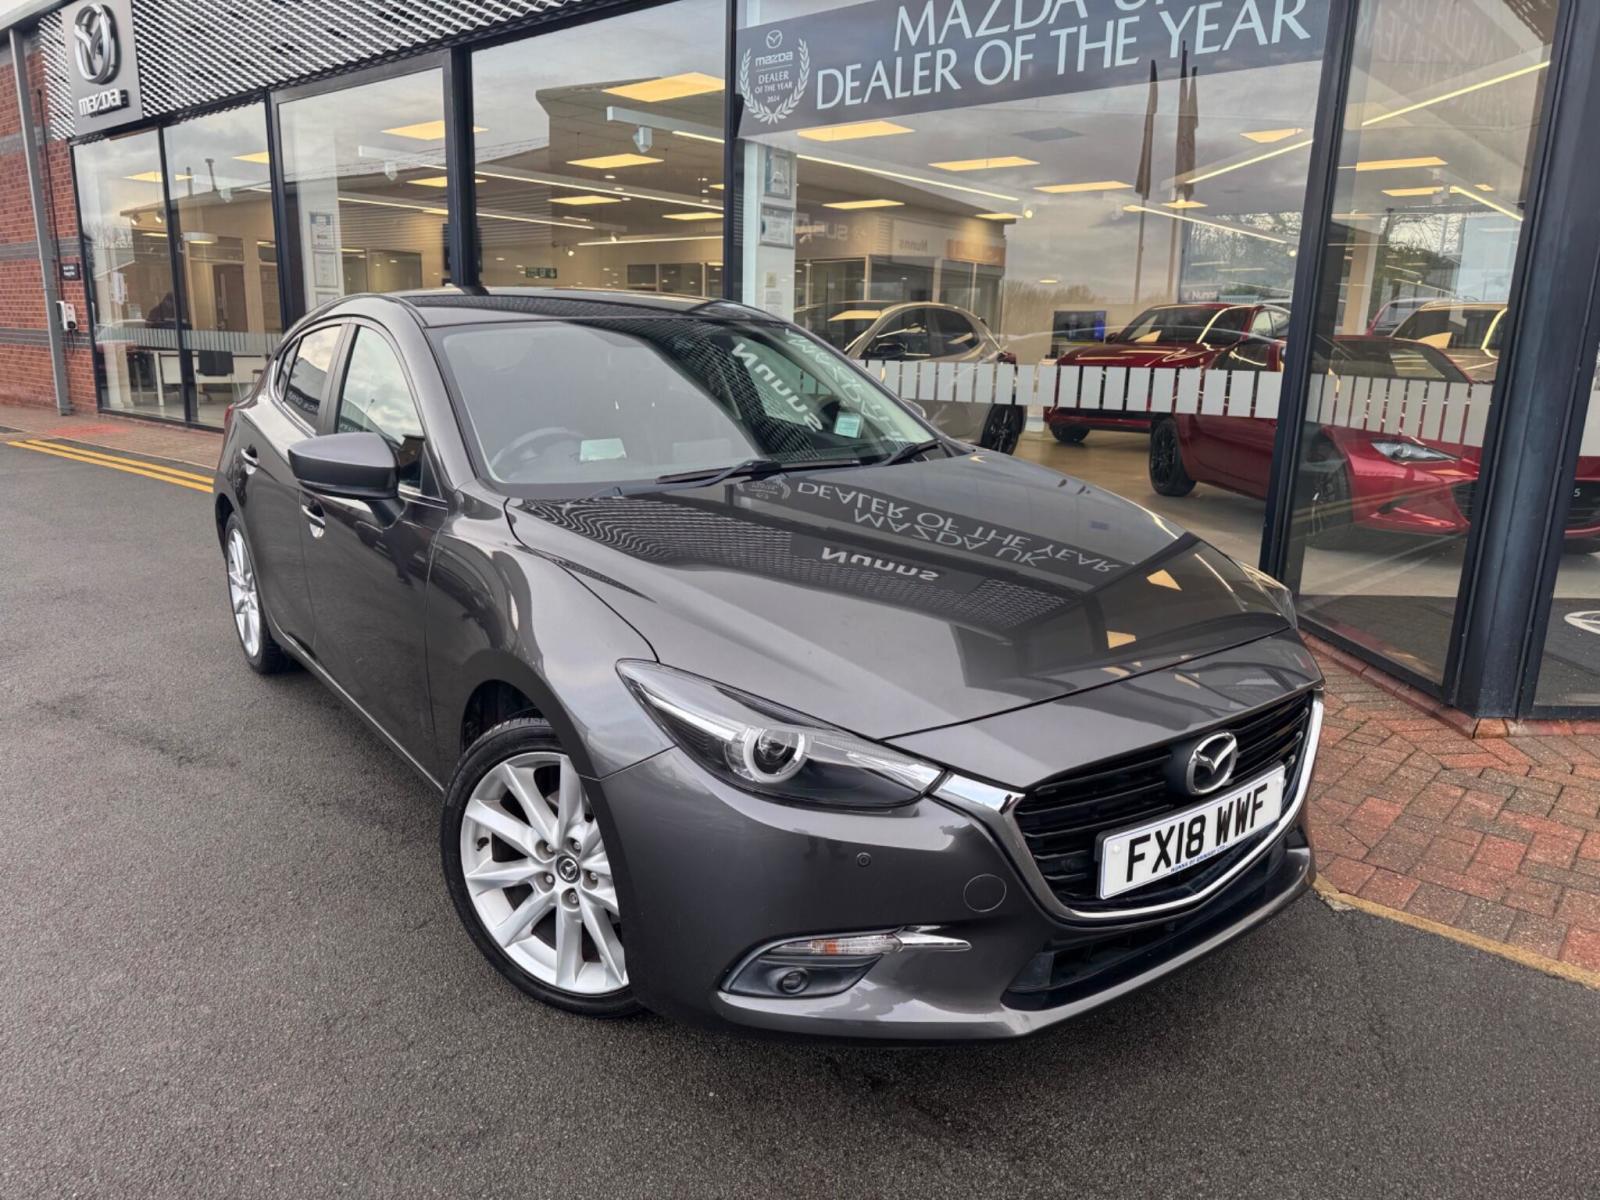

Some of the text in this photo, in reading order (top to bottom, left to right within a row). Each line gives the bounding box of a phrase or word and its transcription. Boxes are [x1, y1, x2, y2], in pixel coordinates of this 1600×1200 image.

[758, 70, 789, 85] DEALER
[816, 0, 1311, 110] DEALER OF THE YEAR
[754, 81, 793, 94] OF THE YEAR
[1126, 783, 1268, 883] FX18 WWF
